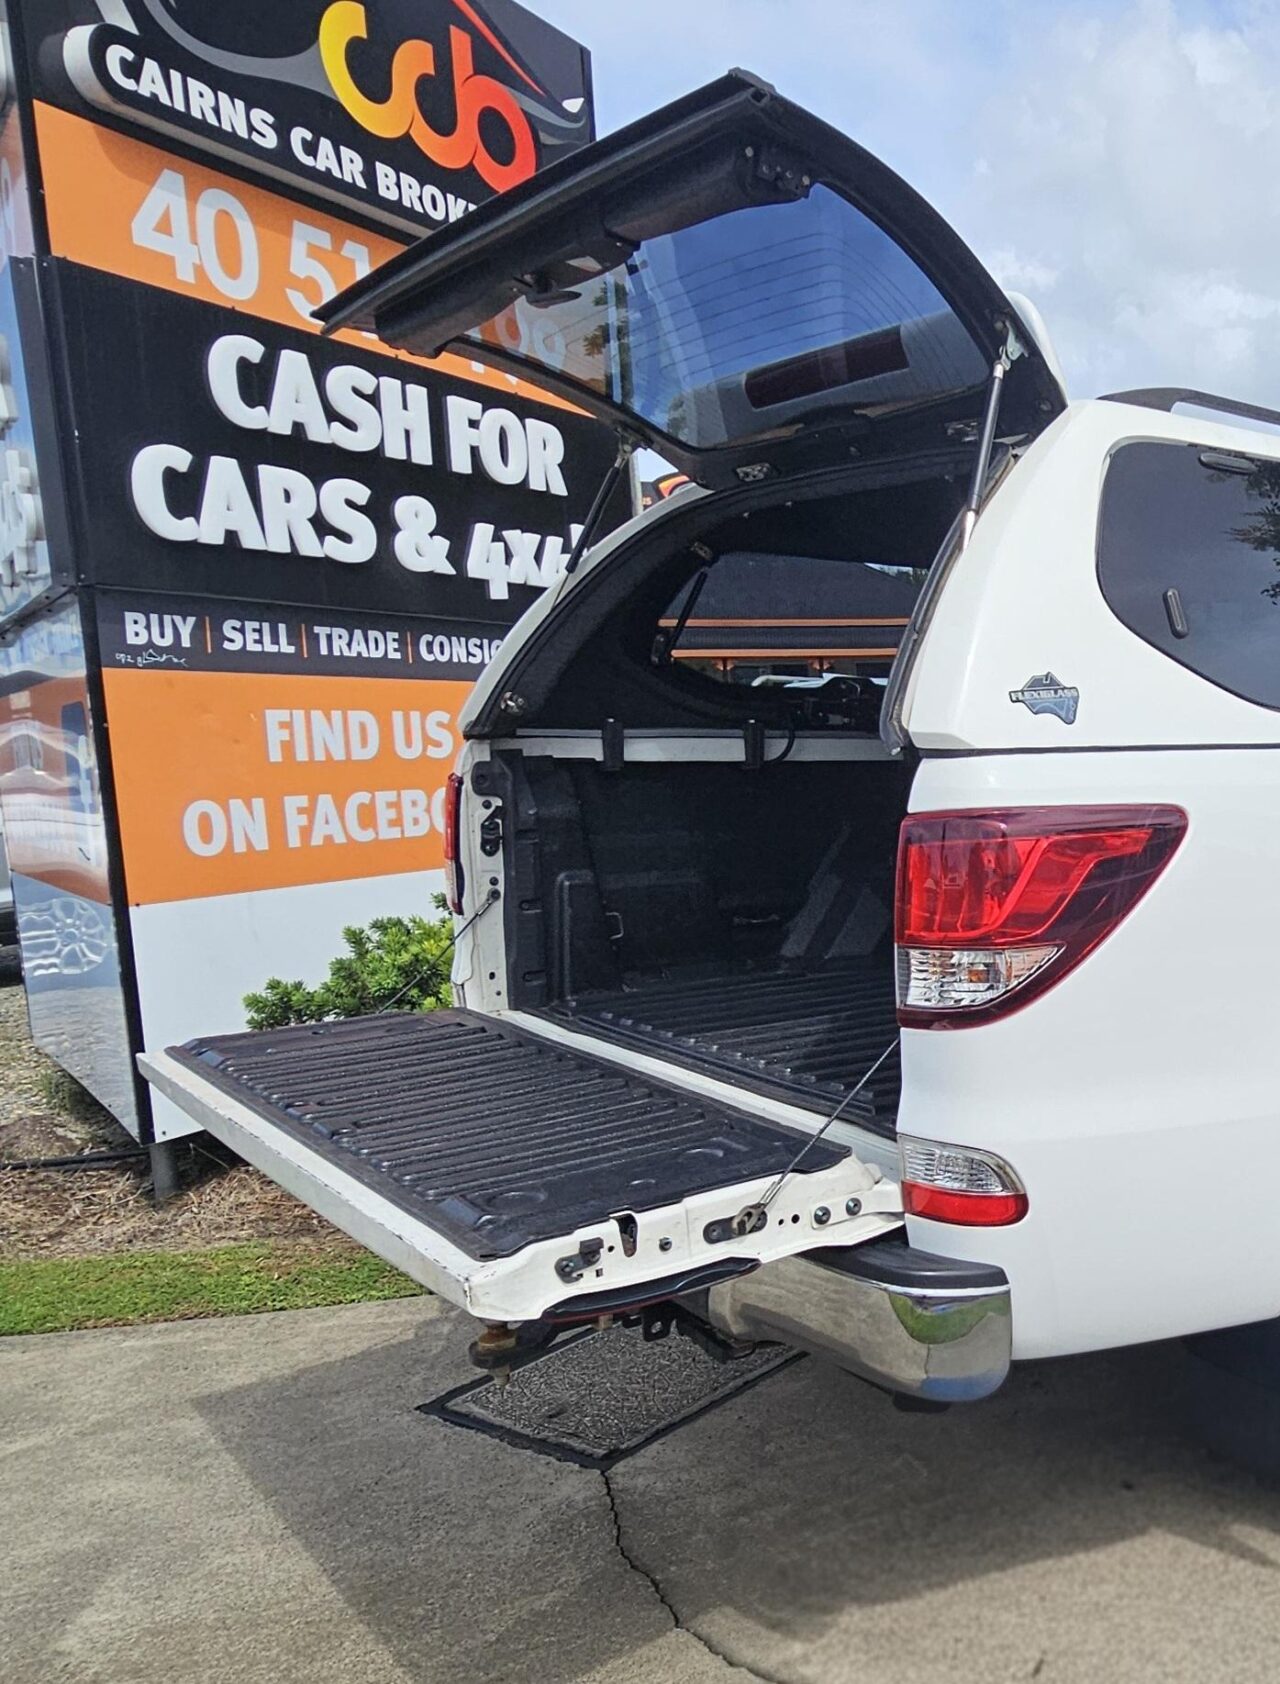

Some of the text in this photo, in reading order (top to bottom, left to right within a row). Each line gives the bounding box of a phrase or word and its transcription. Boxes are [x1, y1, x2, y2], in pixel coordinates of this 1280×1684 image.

[105, 44, 478, 223] CAIRNS CAR BROK
[131, 168, 260, 302] 40
[207, 334, 433, 467] CASH
[446, 394, 568, 497] FOR
[131, 443, 377, 564] CARS
[393, 495, 457, 576] &
[123, 611, 197, 648] BUY
[222, 619, 296, 655] SELL
[313, 625, 402, 661] TRADE
[264, 707, 454, 763] FIND US
[182, 796, 269, 858] ON
